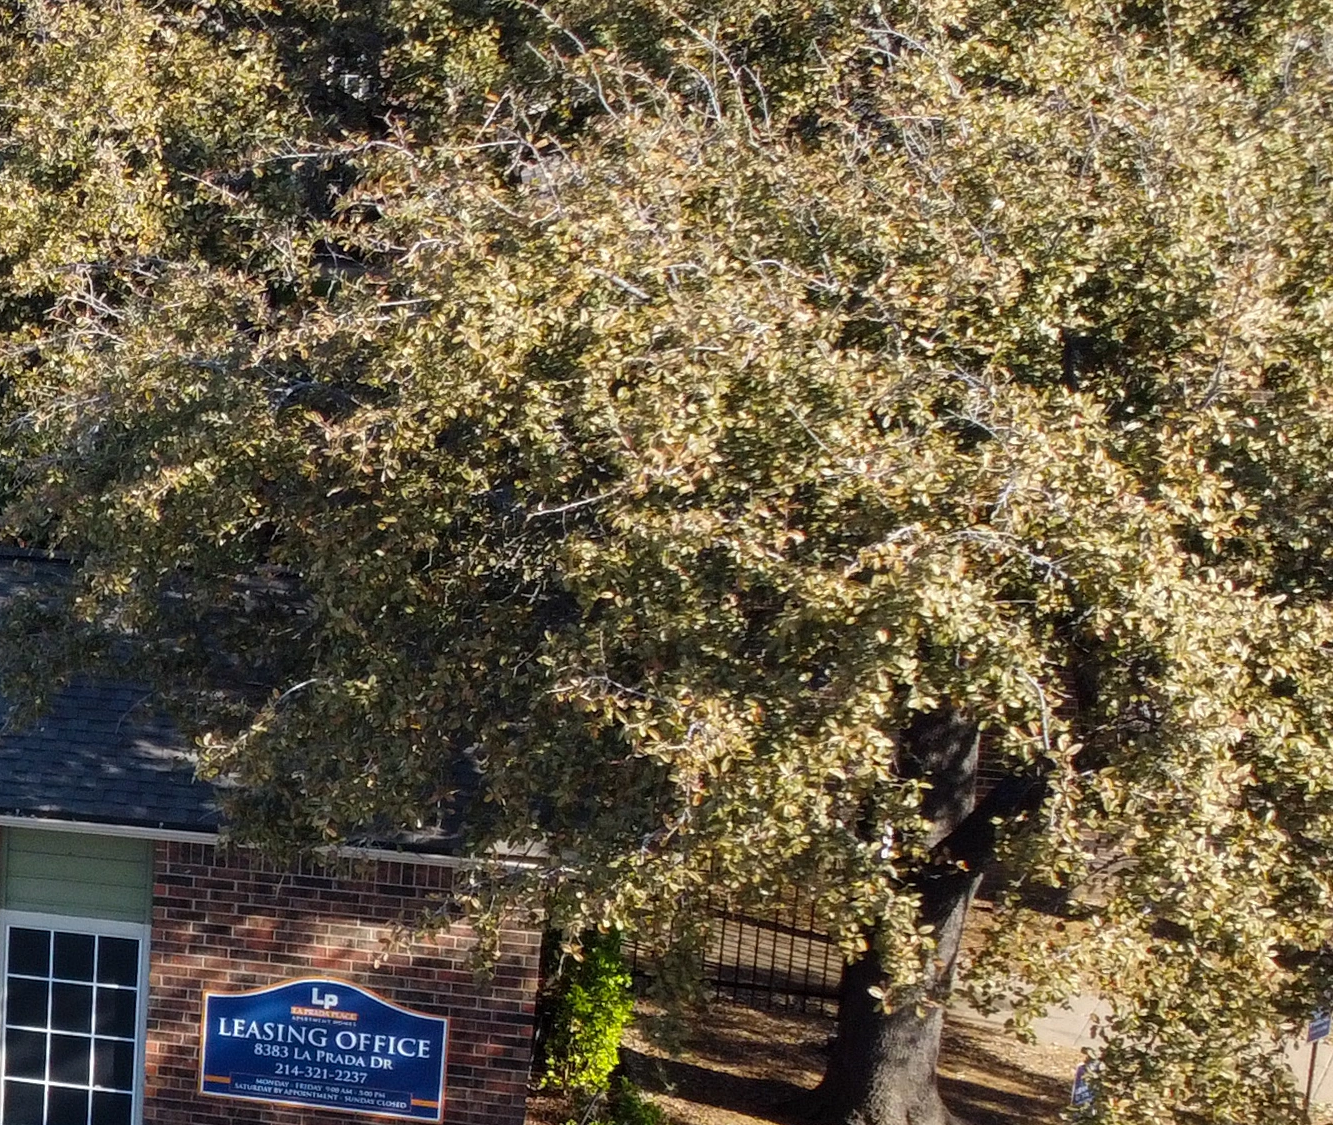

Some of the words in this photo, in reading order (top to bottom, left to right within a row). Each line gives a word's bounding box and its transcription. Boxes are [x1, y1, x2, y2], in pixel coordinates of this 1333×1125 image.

[218, 1017, 328, 1047] LEASING
[334, 1031, 431, 1059] OFFICE
[254, 1043, 289, 1058] 8383
[275, 1062, 368, 1084] 214-321-2237
[234, 1082, 272, 1093] SATURDAY
[283, 1089, 338, 1101] APPOINTMENT
[344, 1095, 375, 1105] SUNDAY
[376, 1100, 408, 1109] CLOSED
[255, 1078, 290, 1088] MONDAY
[295, 1082, 322, 1092] FRIDAY
